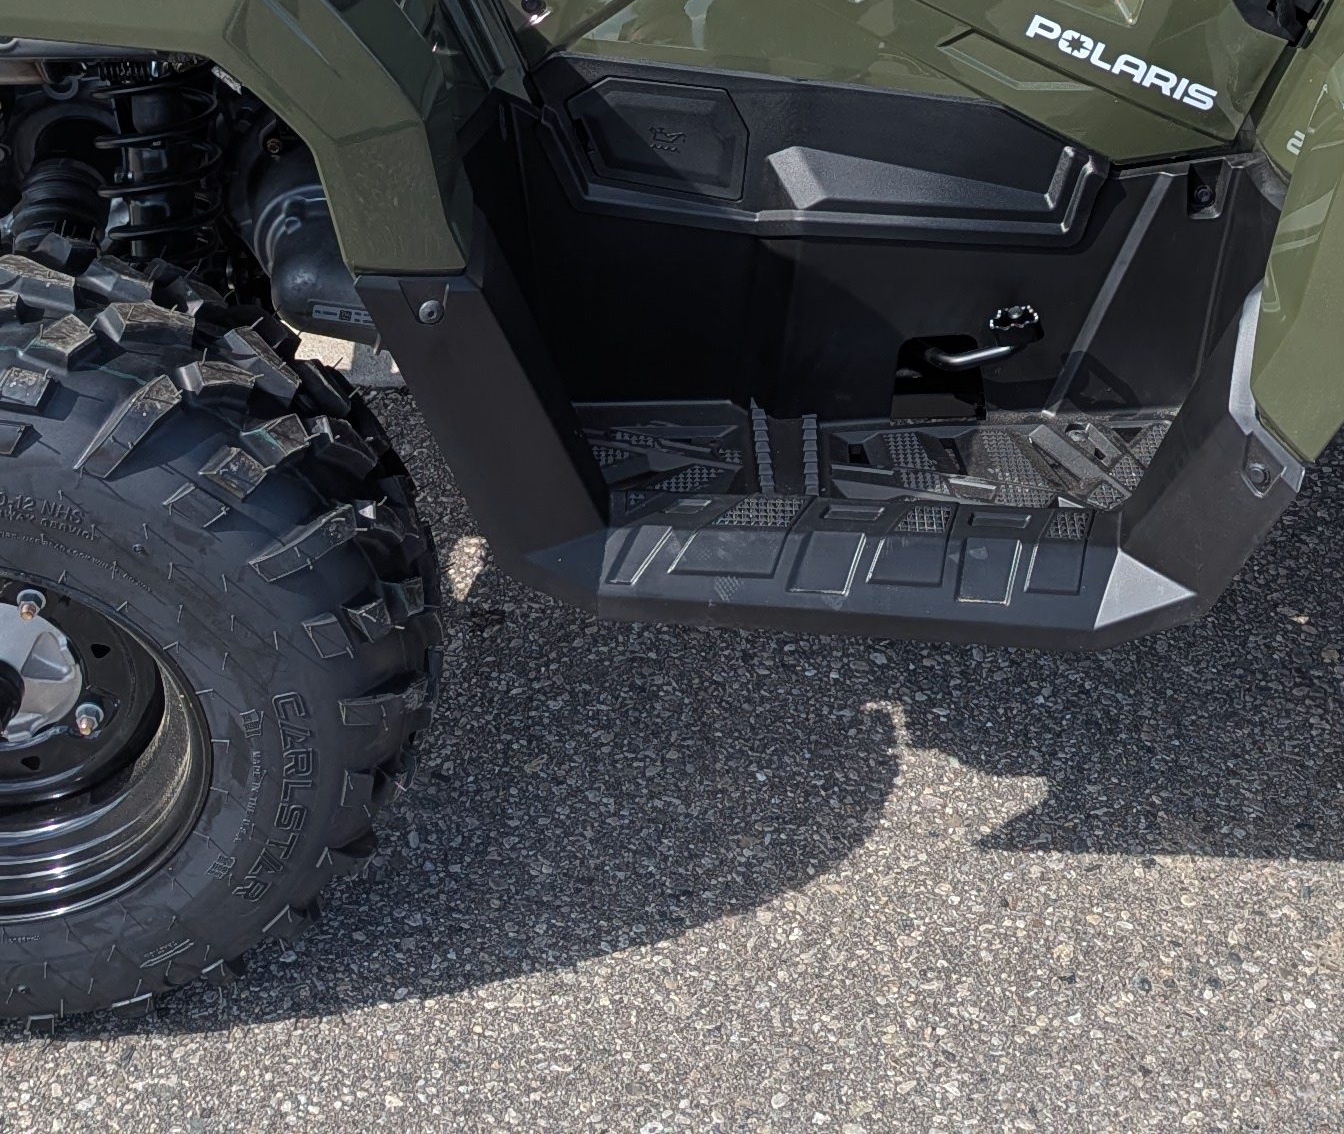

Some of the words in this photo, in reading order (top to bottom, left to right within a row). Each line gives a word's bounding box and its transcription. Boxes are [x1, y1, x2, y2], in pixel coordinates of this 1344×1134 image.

[1026, 15, 1217, 110] POLARIS
[41, 500, 84, 524] NHS
[232, 691, 313, 902] CARLSTAR
